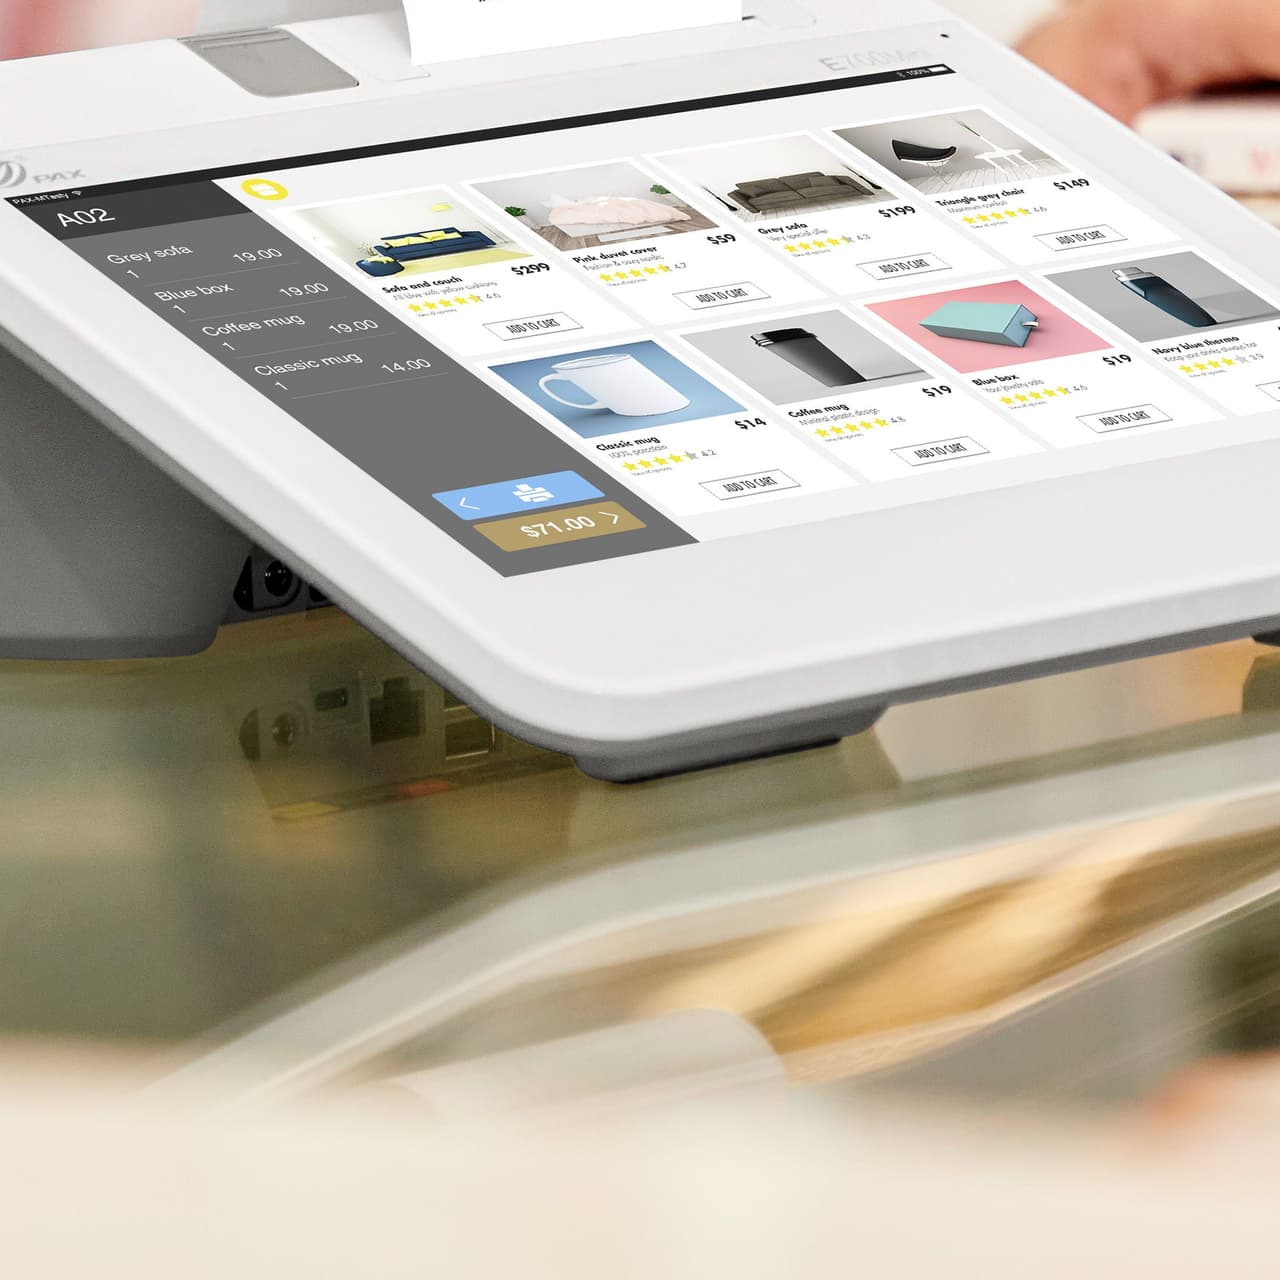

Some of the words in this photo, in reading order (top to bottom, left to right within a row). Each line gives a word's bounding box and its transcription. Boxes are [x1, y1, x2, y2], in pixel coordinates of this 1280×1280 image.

[32, 169, 87, 184] PAX
[1053, 179, 1089, 190] $149
[935, 196, 976, 206] Triangle
[978, 193, 1000, 201] grey
[1001, 188, 1024, 196] chair
[57, 207, 116, 228] A02
[878, 206, 915, 218] $199
[707, 234, 736, 245] $59
[1056, 236, 1075, 245] ADD
[1070, 234, 1087, 242] TO
[1083, 230, 1106, 240] CART
[107, 251, 152, 265] Grey
[154, 245, 194, 258] sofa
[572, 255, 599, 263] Pink
[600, 250, 629, 259] duvet
[126, 269, 140, 279] 1
[233, 248, 283, 263] 19.00
[511, 263, 550, 276] $299
[878, 264, 899, 273] ADD
[894, 262, 910, 270] TO
[907, 259, 930, 268] CART
[154, 289, 198, 302] Blue
[196, 283, 235, 295] box
[382, 285, 408, 293] Sofa
[410, 281, 431, 289] and
[432, 276, 463, 285] couch
[173, 304, 187, 314] 1
[280, 282, 329, 297] 19.00
[696, 294, 716, 303] ADD
[711, 292, 728, 300] TO
[725, 288, 748, 298] CART
[202, 321, 262, 337] Coffee
[263, 315, 306, 328] mug
[506, 324, 527, 334] ADD
[523, 322, 540, 331] TO
[537, 318, 560, 328] CART
[222, 341, 236, 351] 1
[329, 319, 379, 334] 19.00
[1152, 347, 1181, 355] Navy
[1203, 337, 1240, 346] thermo
[255, 359, 320, 376] Classic
[320, 353, 364, 366] mug
[1102, 354, 1131, 366] $19
[275, 381, 289, 391] 1
[382, 358, 432, 374] 14.00
[922, 385, 951, 397] $19
[788, 409, 823, 417] Coffee
[824, 404, 849, 412] mug
[1099, 417, 1119, 426] ADD
[1114, 415, 1131, 423] TO
[1128, 411, 1151, 420] CART
[735, 418, 767, 430] $14
[596, 441, 634, 451] Classic
[634, 437, 660, 445] mug
[914, 449, 935, 459] ADD
[930, 447, 947, 455] TO
[944, 443, 967, 453] CART
[722, 483, 744, 492] ADD
[739, 480, 756, 489] TO
[753, 476, 778, 487] CART
[521, 515, 596, 539] $71.00
